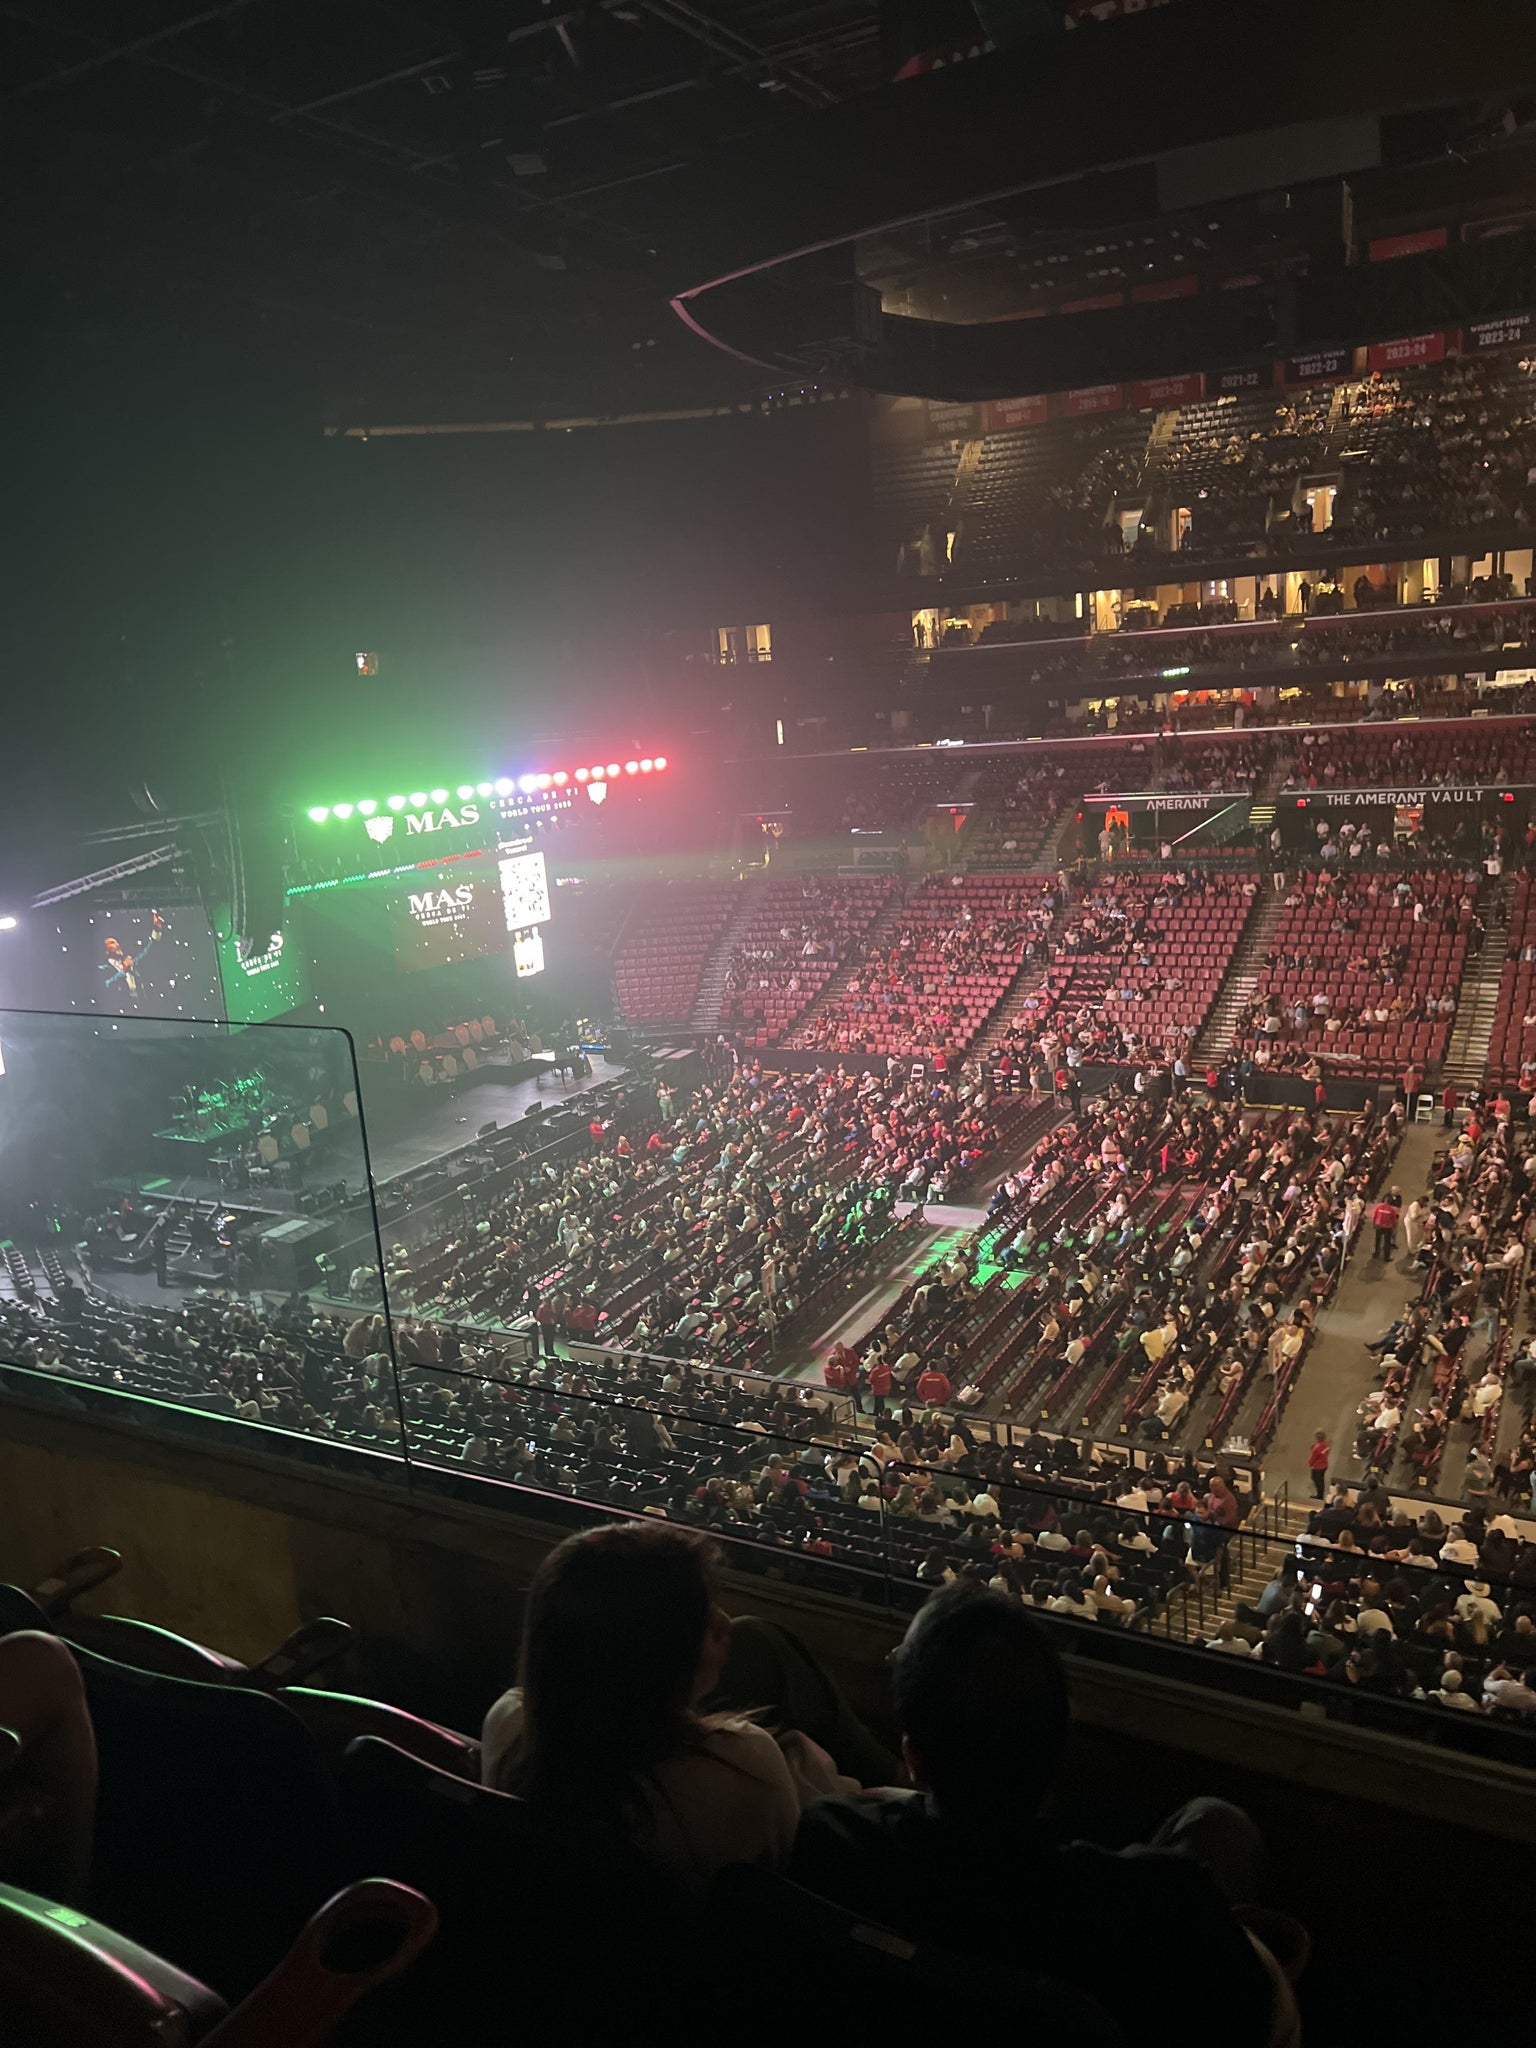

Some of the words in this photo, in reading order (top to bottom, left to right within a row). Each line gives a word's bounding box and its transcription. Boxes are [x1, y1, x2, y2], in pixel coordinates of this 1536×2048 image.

[490, 795, 533, 809] CERCA
[542, 790, 558, 802] DE
[565, 786, 579, 798] TI
[1146, 798, 1210, 811] AMERANT
[1326, 794, 1351, 807] THE
[1354, 791, 1427, 807] AMERANT
[1431, 790, 1484, 804] VAULT
[404, 804, 480, 835] MAS
[500, 808, 528, 819] WORLD
[530, 803, 551, 814] TOUR
